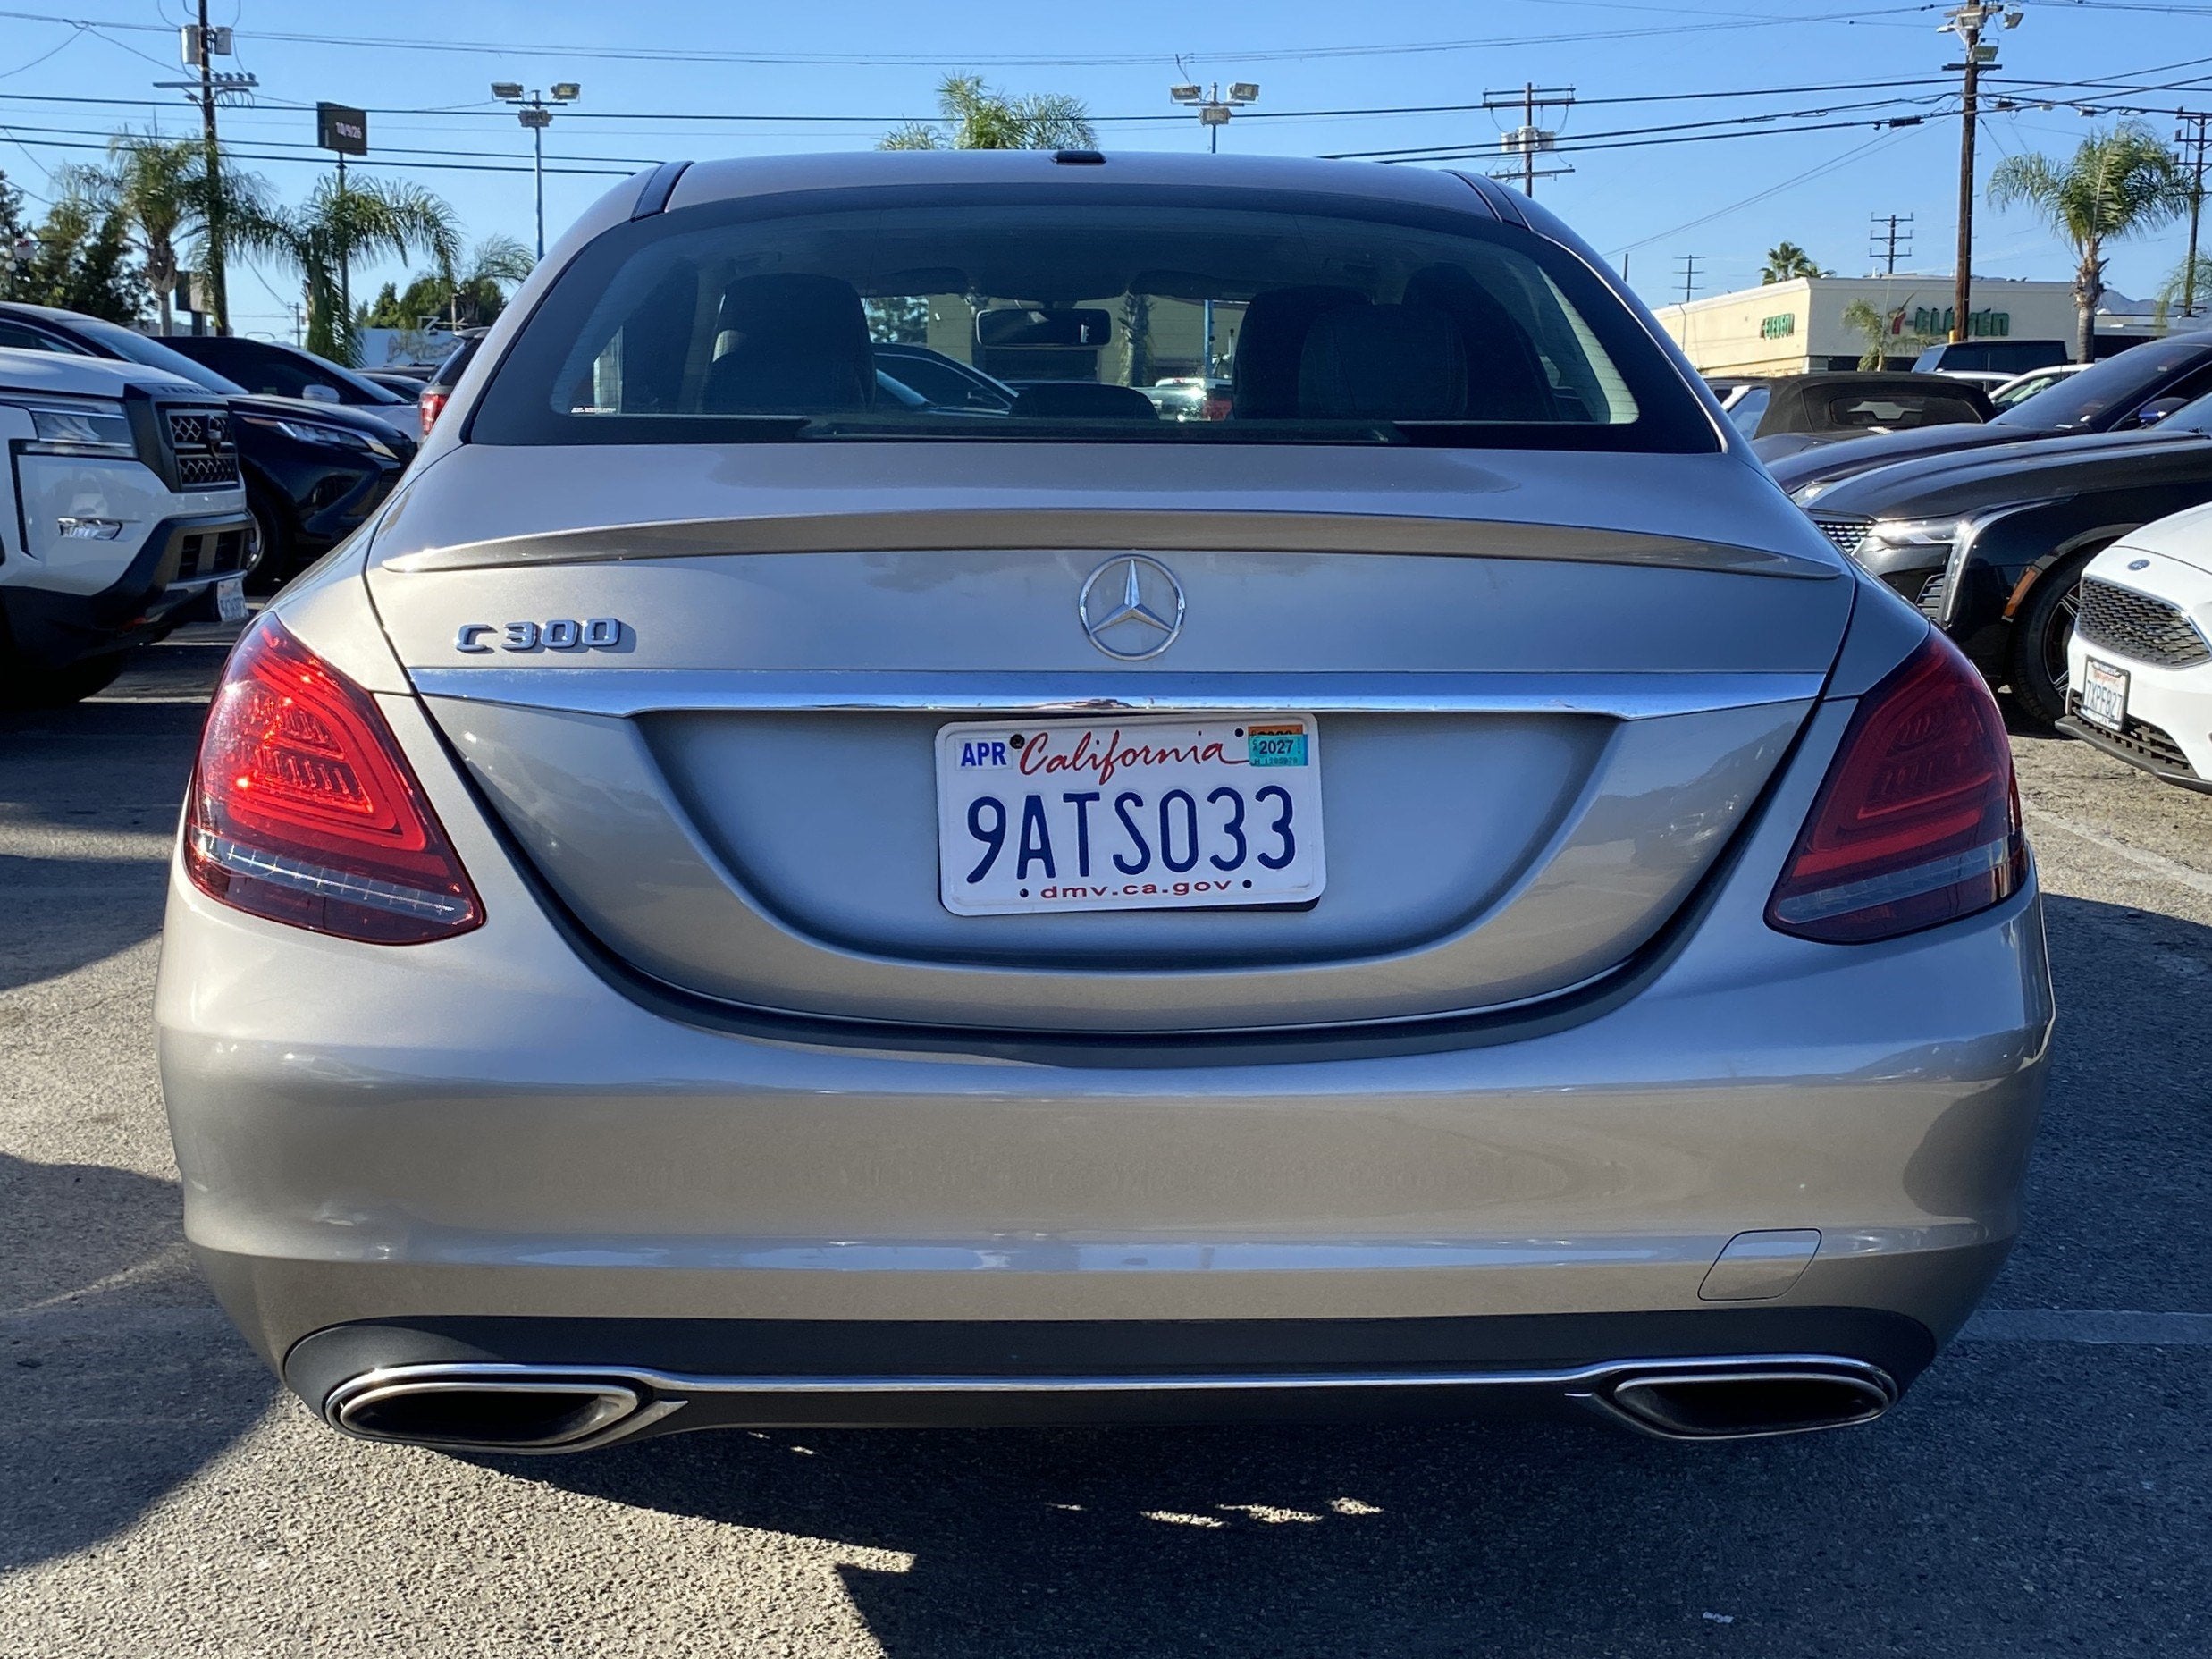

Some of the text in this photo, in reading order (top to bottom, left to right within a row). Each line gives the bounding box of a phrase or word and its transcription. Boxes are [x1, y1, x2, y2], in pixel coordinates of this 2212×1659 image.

[455, 618, 620, 653] C 300
[961, 741, 1007, 767] APR
[1020, 729, 1249, 786] California
[1258, 739, 1294, 755] 2027
[966, 785, 1296, 884] 9ATS033
[1040, 880, 1232, 899] dmv.ca.gov
